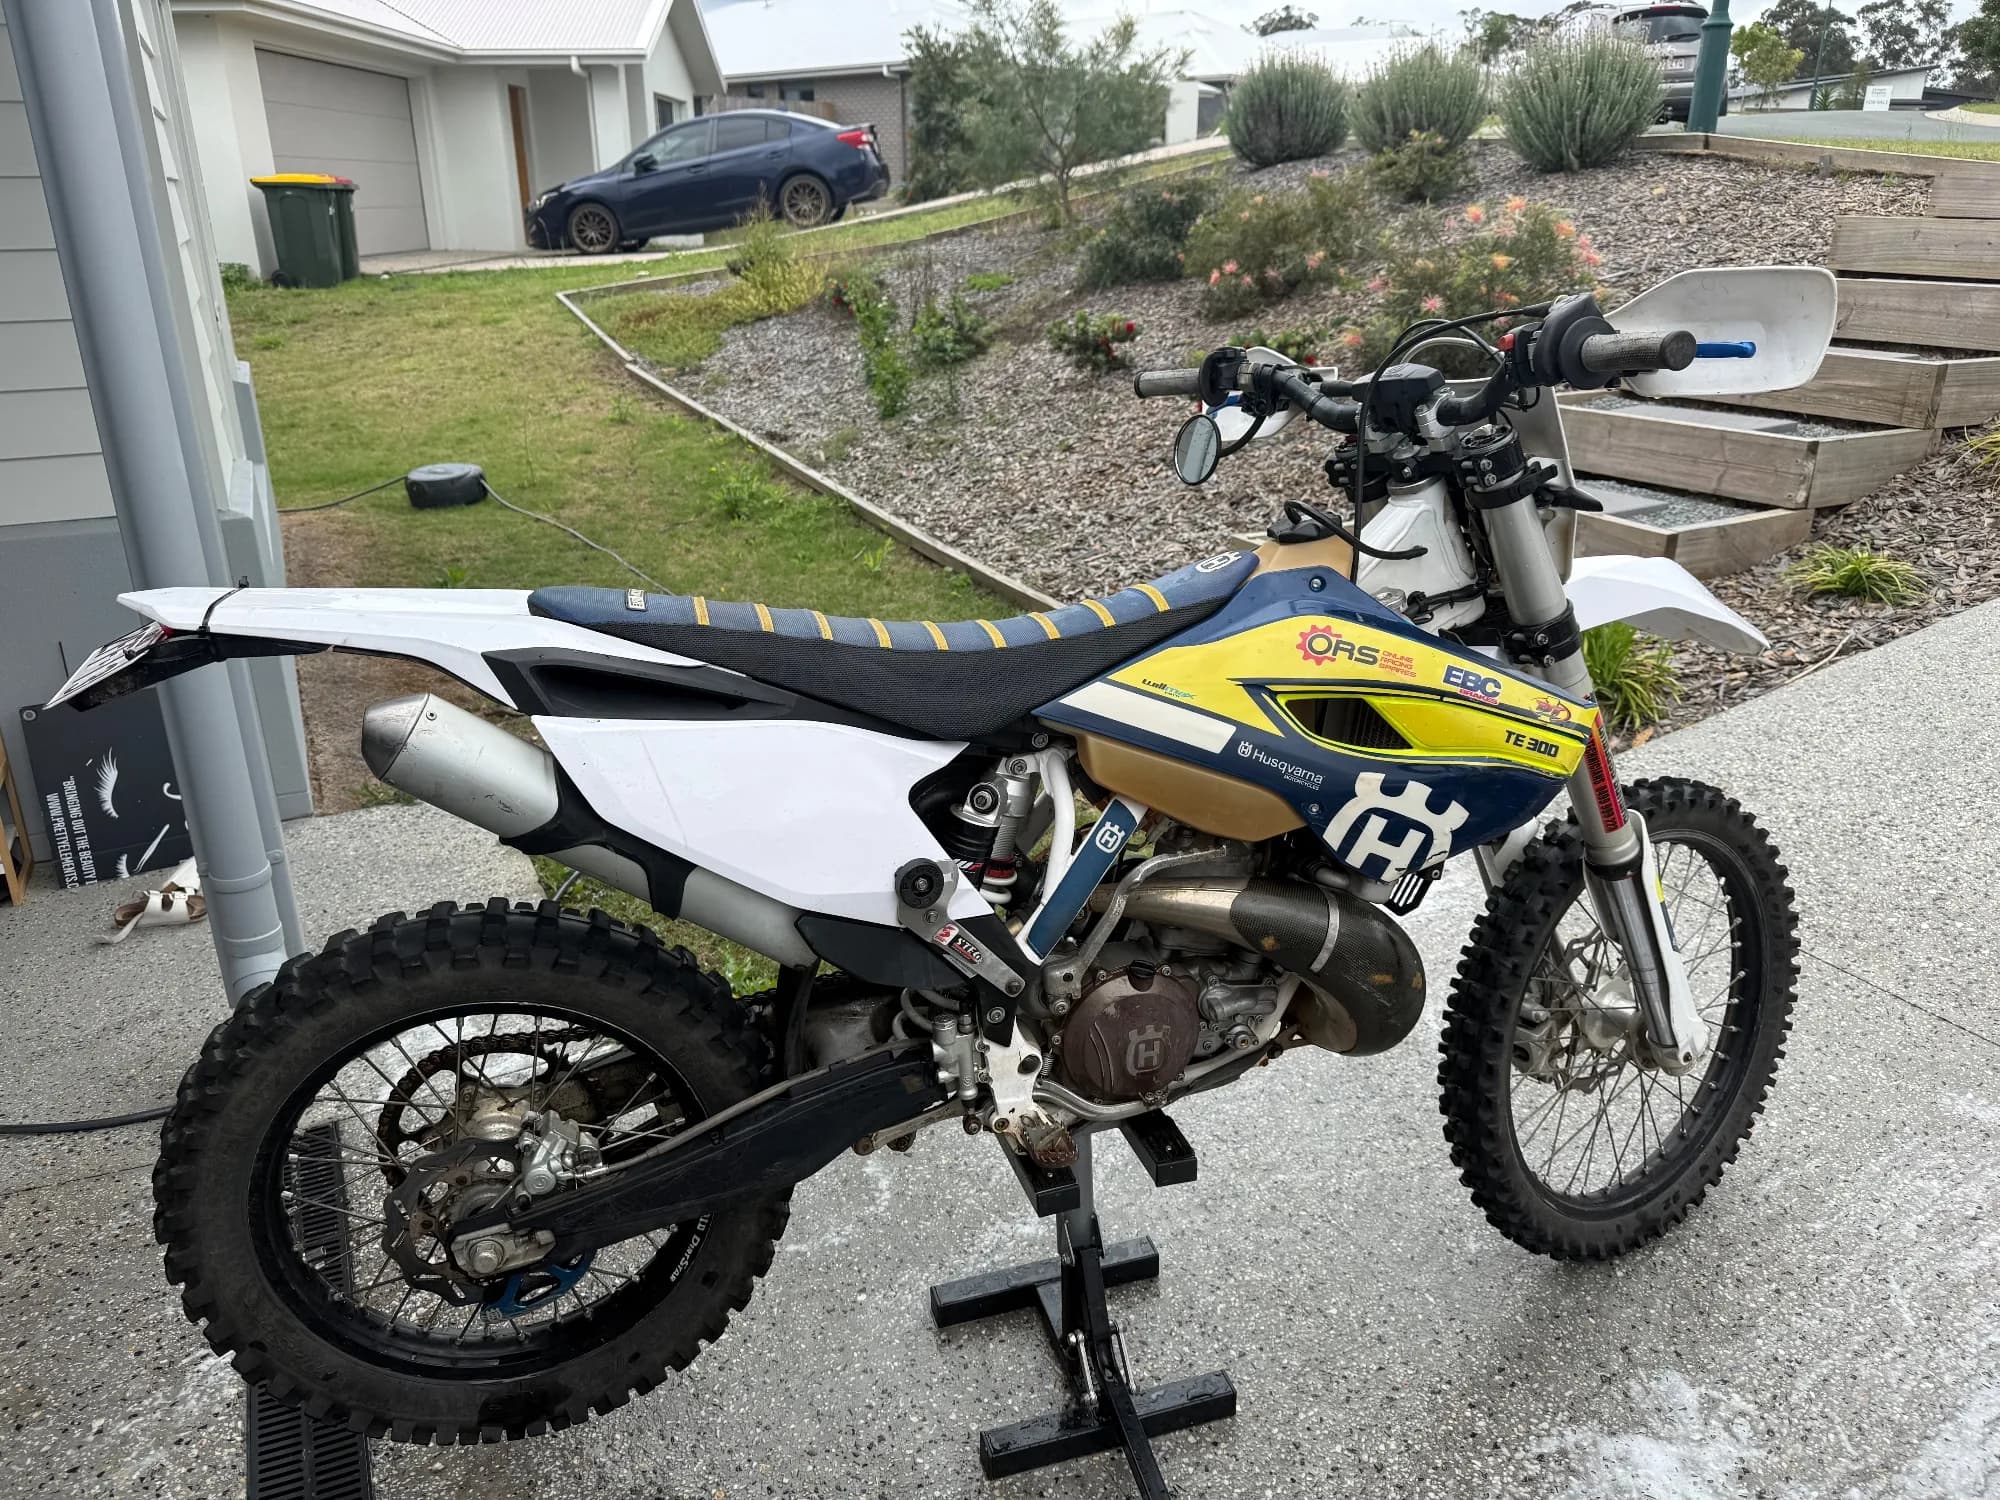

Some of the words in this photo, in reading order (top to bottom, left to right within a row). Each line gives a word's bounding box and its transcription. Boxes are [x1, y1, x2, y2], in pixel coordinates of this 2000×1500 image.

[1308, 633, 1380, 665] ORS
[1382, 650, 1414, 663] ONLINE
[1380, 657, 1413, 670] RACING
[1443, 665, 1502, 698] EBC
[1459, 688, 1498, 705] BRAKES
[1505, 730, 1526, 748] TE
[1526, 738, 1559, 757] 300
[1252, 748, 1323, 784] Husqvarna
[71, 819, 86, 834] OUT
[75, 834, 90, 850] THE
[79, 850, 97, 879] BEAUTY
